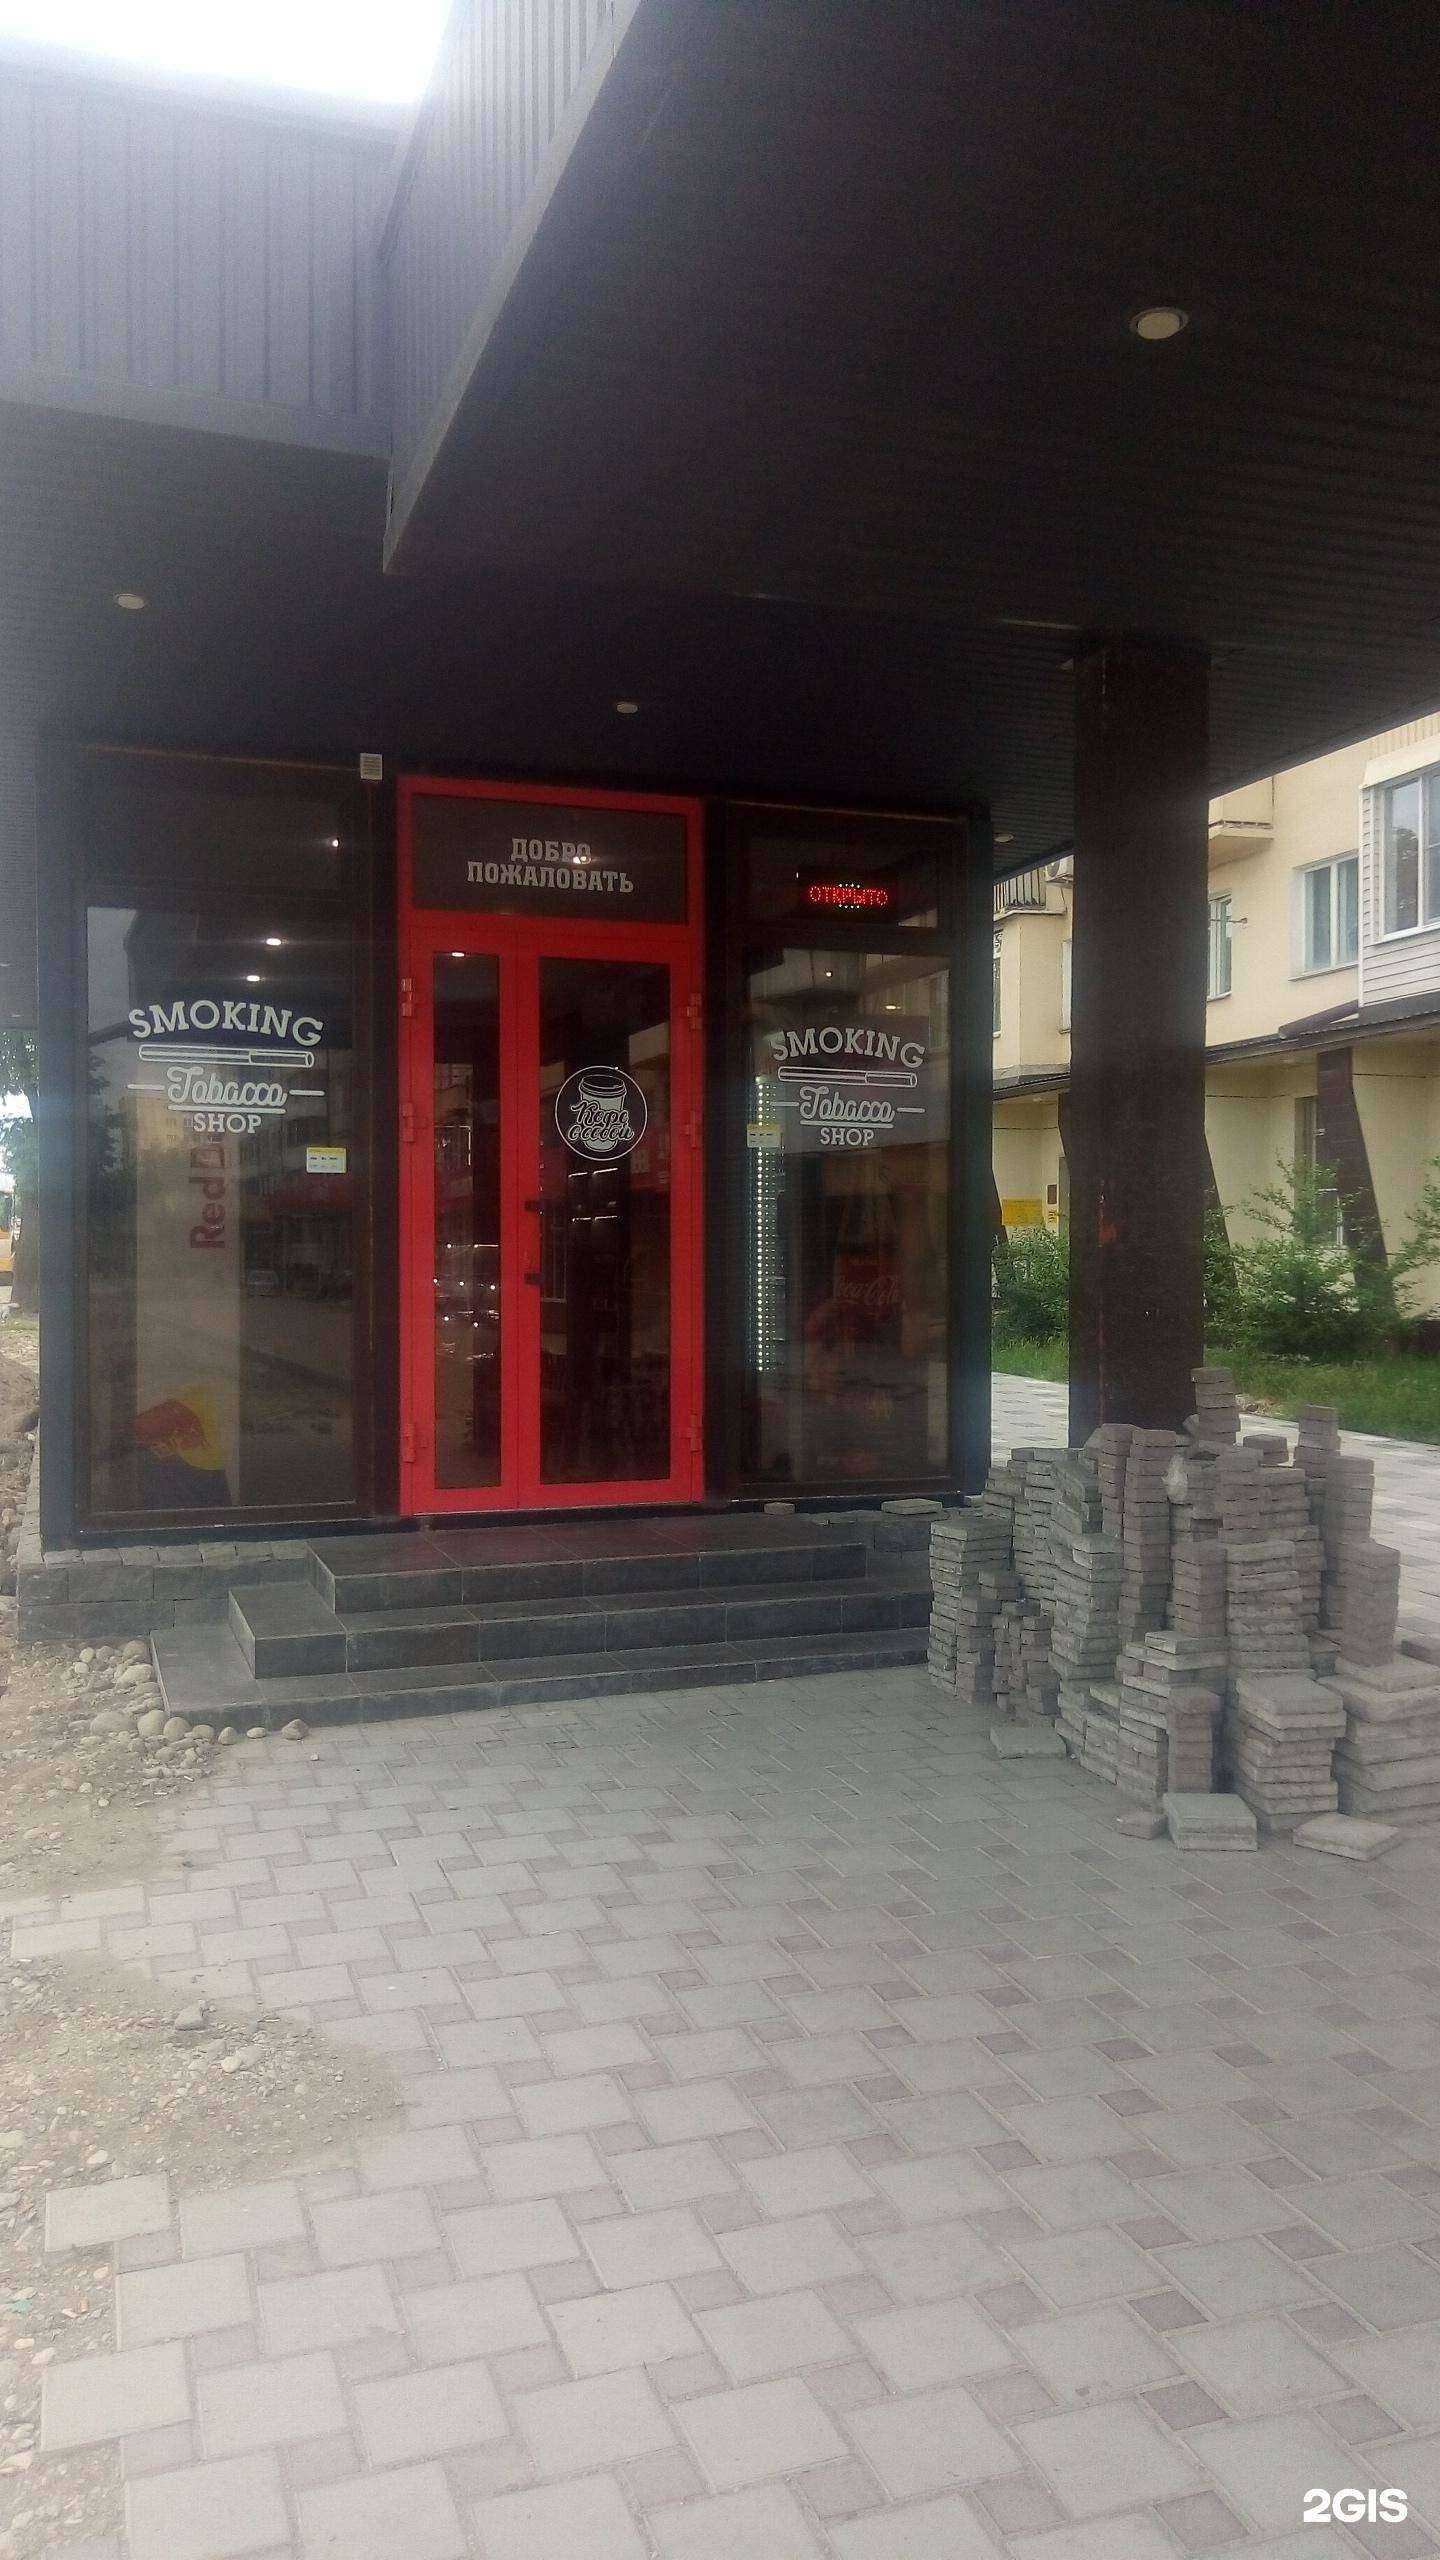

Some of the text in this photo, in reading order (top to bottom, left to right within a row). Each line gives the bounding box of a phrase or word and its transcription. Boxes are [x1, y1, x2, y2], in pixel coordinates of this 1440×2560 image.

[510, 838, 592, 865] ДОБРО
[467, 861, 635, 893] ПОЖАЛОВАТЬ
[809, 886, 888, 906] ОТКРЫТО
[128, 999, 323, 1046] SMOKING
[769, 1026, 926, 1068] SMOKING
[166, 1065, 288, 1107] Tobacco
[799, 1085, 896, 1123] Tobacco
[193, 1112, 262, 1134] SHOP
[820, 1127, 875, 1146] SHOP
